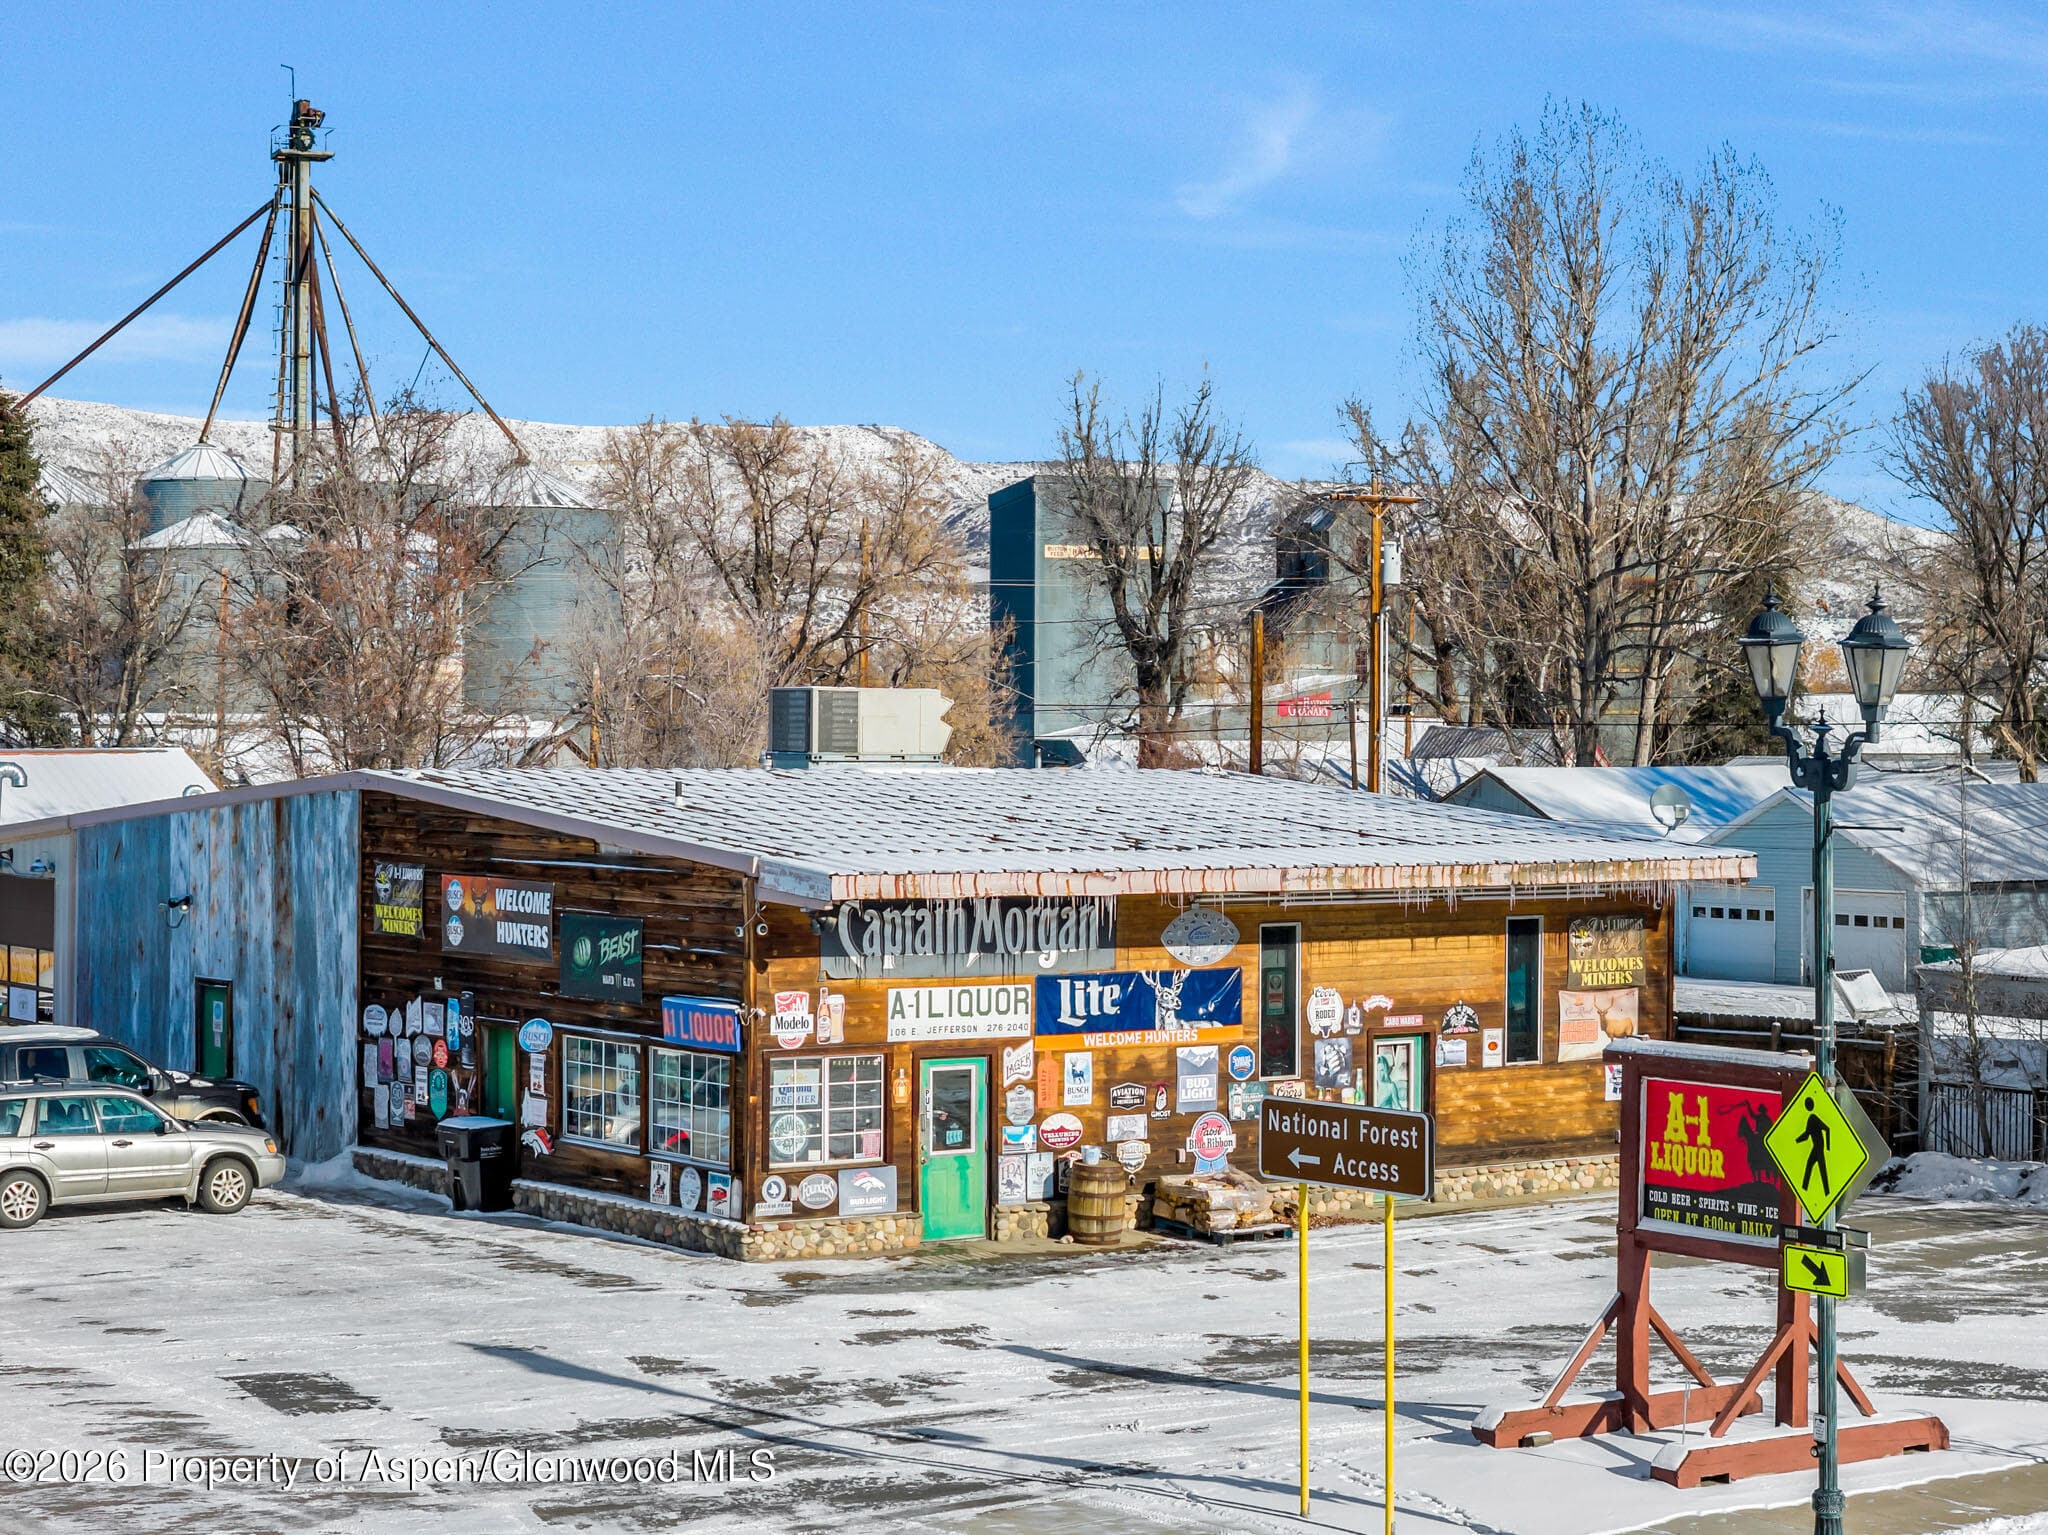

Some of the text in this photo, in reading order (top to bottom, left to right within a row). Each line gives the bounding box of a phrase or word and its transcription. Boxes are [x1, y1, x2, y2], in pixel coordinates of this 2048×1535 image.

[1287, 704, 1329, 717] GRANARY
[495, 888, 551, 915] WELCOME
[374, 903, 422, 922] WELCOMES
[381, 918, 416, 936] MINERS
[496, 921, 549, 949] HUNTERS
[838, 897, 1099, 970] Captain Morgan
[599, 929, 640, 966] BEAST
[1570, 956, 1644, 973] WELCOMES
[1581, 970, 1633, 986] MINERS
[1314, 988, 1336, 998] Coors
[890, 986, 1030, 1019] A-1 LIQUOR
[1057, 978, 1121, 1027] Lite
[775, 1015, 810, 1030] Modelo
[1315, 1009, 1336, 1020] RODEO
[680, 1008, 736, 1045] LIQUOR
[890, 1027, 907, 1037] 106
[926, 1024, 978, 1034] JEFFERSON
[522, 1030, 550, 1044] BUSCH
[1083, 1028, 1198, 1047] WELCOME HUNTERS
[1006, 1052, 1032, 1076] LAGER
[1067, 1086, 1089, 1095] BUSCH
[1186, 1077, 1210, 1088] BUD
[1276, 1085, 1303, 1098] Coors
[775, 1095, 816, 1105] PREMIER
[1112, 1087, 1145, 1097] AVIATION
[1181, 1087, 1214, 1099] LIGHT
[1150, 1109, 1171, 1118] GHOST
[1663, 1091, 1712, 1148] A-1
[1200, 1121, 1223, 1137] Pabst
[1268, 1108, 1418, 1149] National Forest
[1188, 1136, 1233, 1150] Blue Ribbon
[1333, 1153, 1399, 1183] Access
[1650, 1141, 1725, 1179] LIQUOR
[1001, 1162, 1023, 1180] IPA
[802, 1179, 835, 1199] Founders
[849, 1196, 888, 1206] BUD LIGHT
[1649, 1189, 1779, 1220] COLD BEER SPIRITS WINE ICE
[1654, 1207, 1680, 1223] OPEN
[1685, 1211, 1699, 1226] AT
[1741, 1220, 1773, 1238] DAILY
